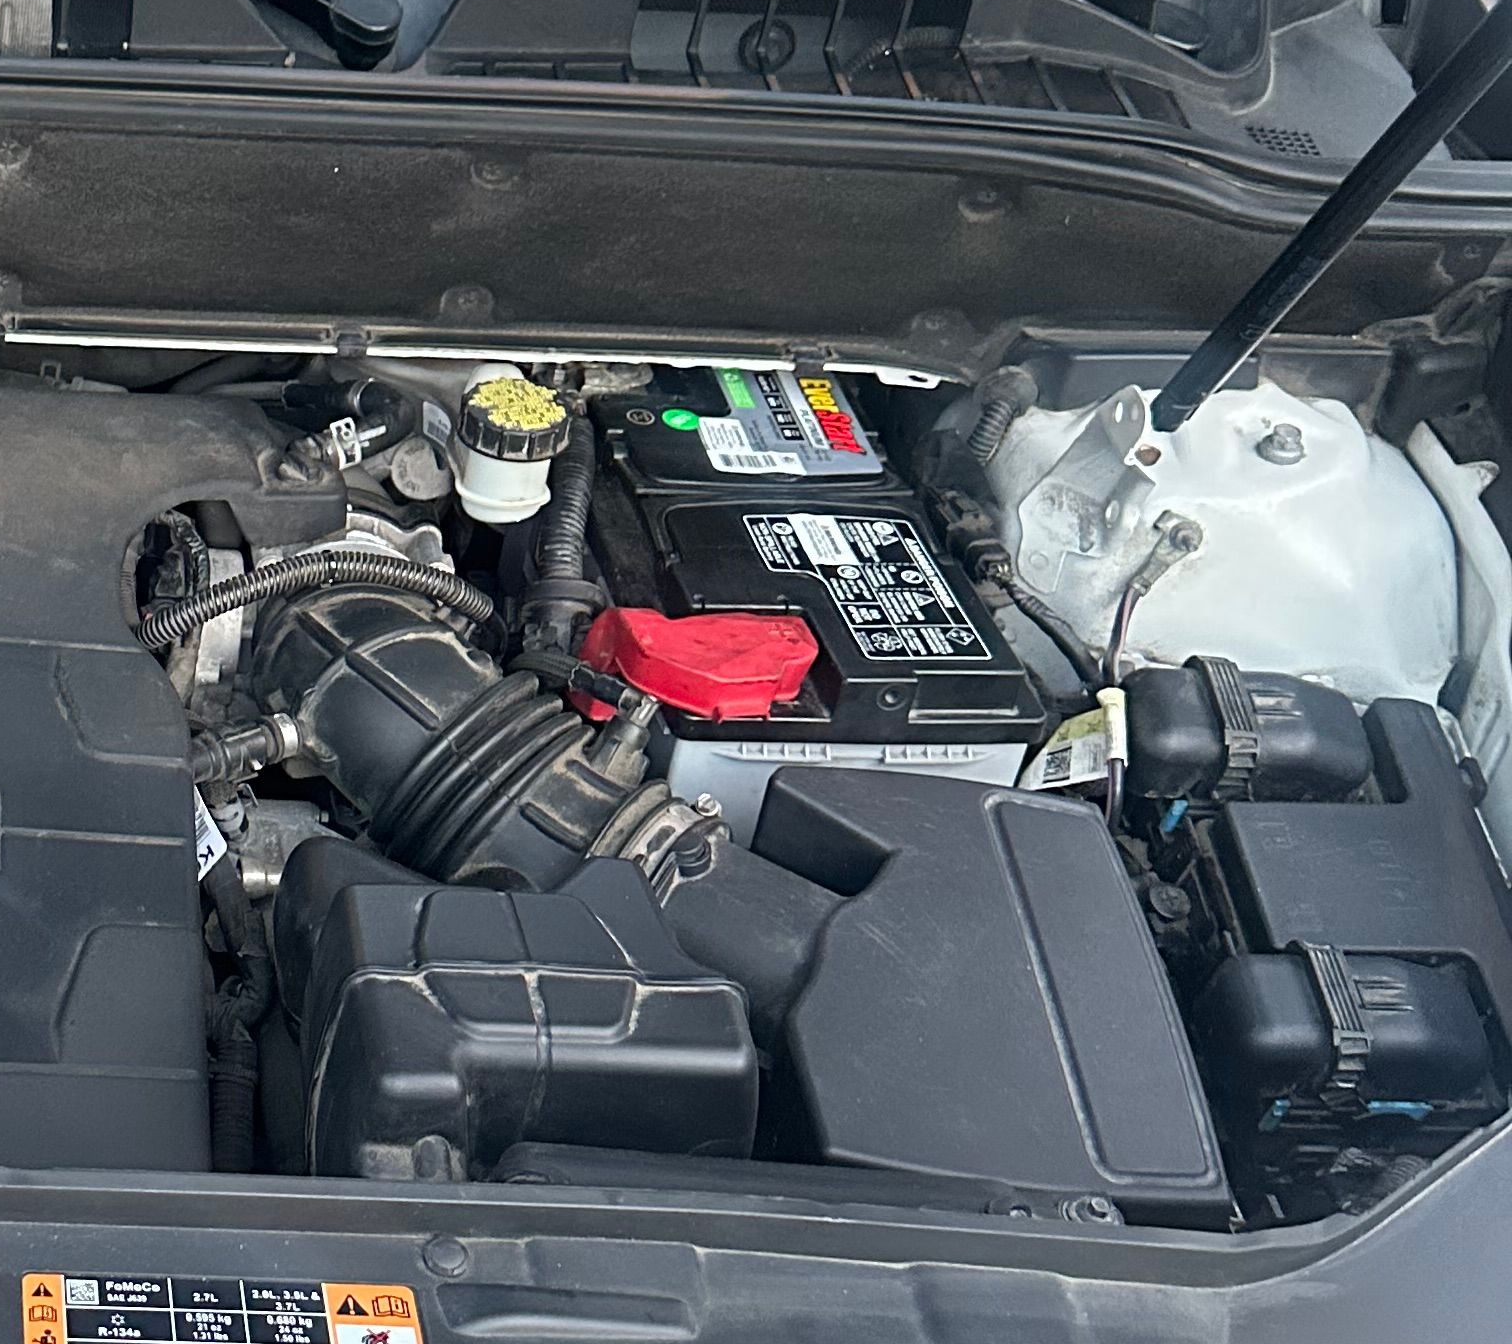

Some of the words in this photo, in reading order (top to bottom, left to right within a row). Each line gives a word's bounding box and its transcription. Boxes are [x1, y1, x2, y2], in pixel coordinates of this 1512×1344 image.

[799, 377, 866, 455] EverStart
[105, 1281, 161, 1293] FoMoCo
[193, 1292, 219, 1303] 2.7L
[275, 1301, 301, 1312] 3.7L
[217, 1313, 232, 1326] kg
[298, 1316, 313, 1329] kg
[97, 1326, 141, 1338] R-134a
